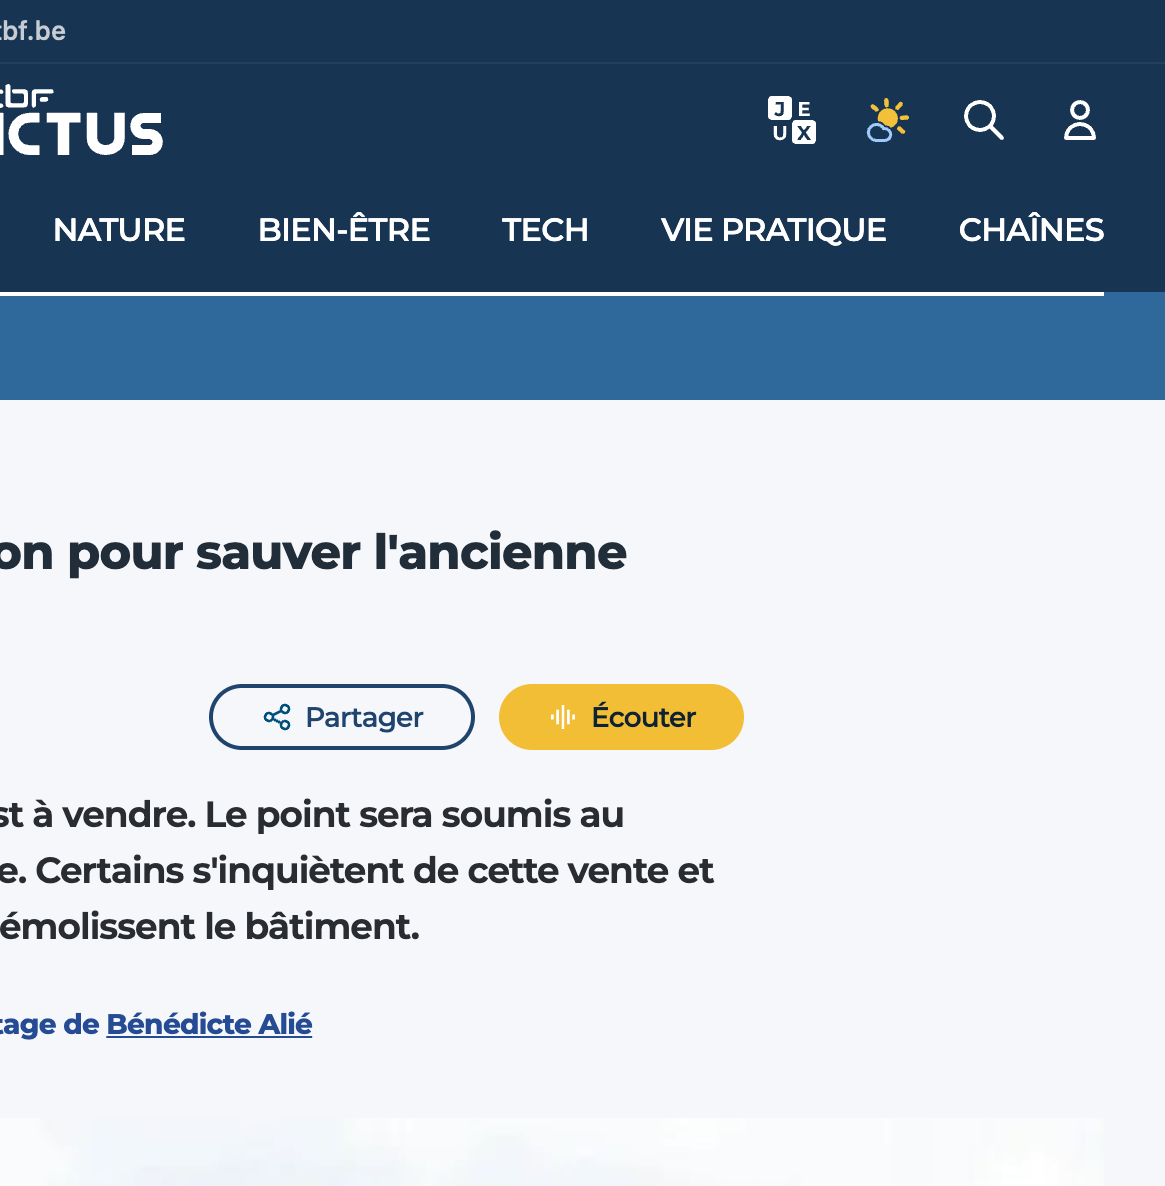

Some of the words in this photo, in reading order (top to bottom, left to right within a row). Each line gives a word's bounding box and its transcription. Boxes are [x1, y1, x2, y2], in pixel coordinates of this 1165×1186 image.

[55, 218, 185, 242] NATURE
[260, 212, 430, 241] BIEN-ÊTRE
[502, 218, 587, 242] TECH
[661, 218, 712, 241] VIE
[724, 218, 886, 246] PRATIQUE
[960, 212, 1104, 242] CHAÎNES
[70, 542, 183, 578] pour
[197, 542, 361, 570] sauver
[376, 530, 627, 570] l'ancienne
[308, 707, 424, 733] Partager
[593, 702, 696, 727] Écouter
[33, 800, 52, 827] à
[62, 800, 195, 827] vendre.
[207, 801, 247, 827] Le
[258, 798, 351, 834] point
[360, 807, 431, 827] sera
[442, 798, 571, 827] soumis
[581, 807, 623, 827] au
[36, 854, 184, 883] Certains
[193, 854, 404, 890] s'inquiètent
[414, 856, 458, 883] de
[468, 859, 559, 883] cette
[567, 859, 668, 883] vente
[678, 859, 714, 883] et
[207, 912, 235, 939] le
[247, 910, 419, 939] bâtiment.
[64, 1013, 99, 1034] de
[108, 1011, 251, 1034] Bénédicte
[258, 1011, 312, 1034] Alié
